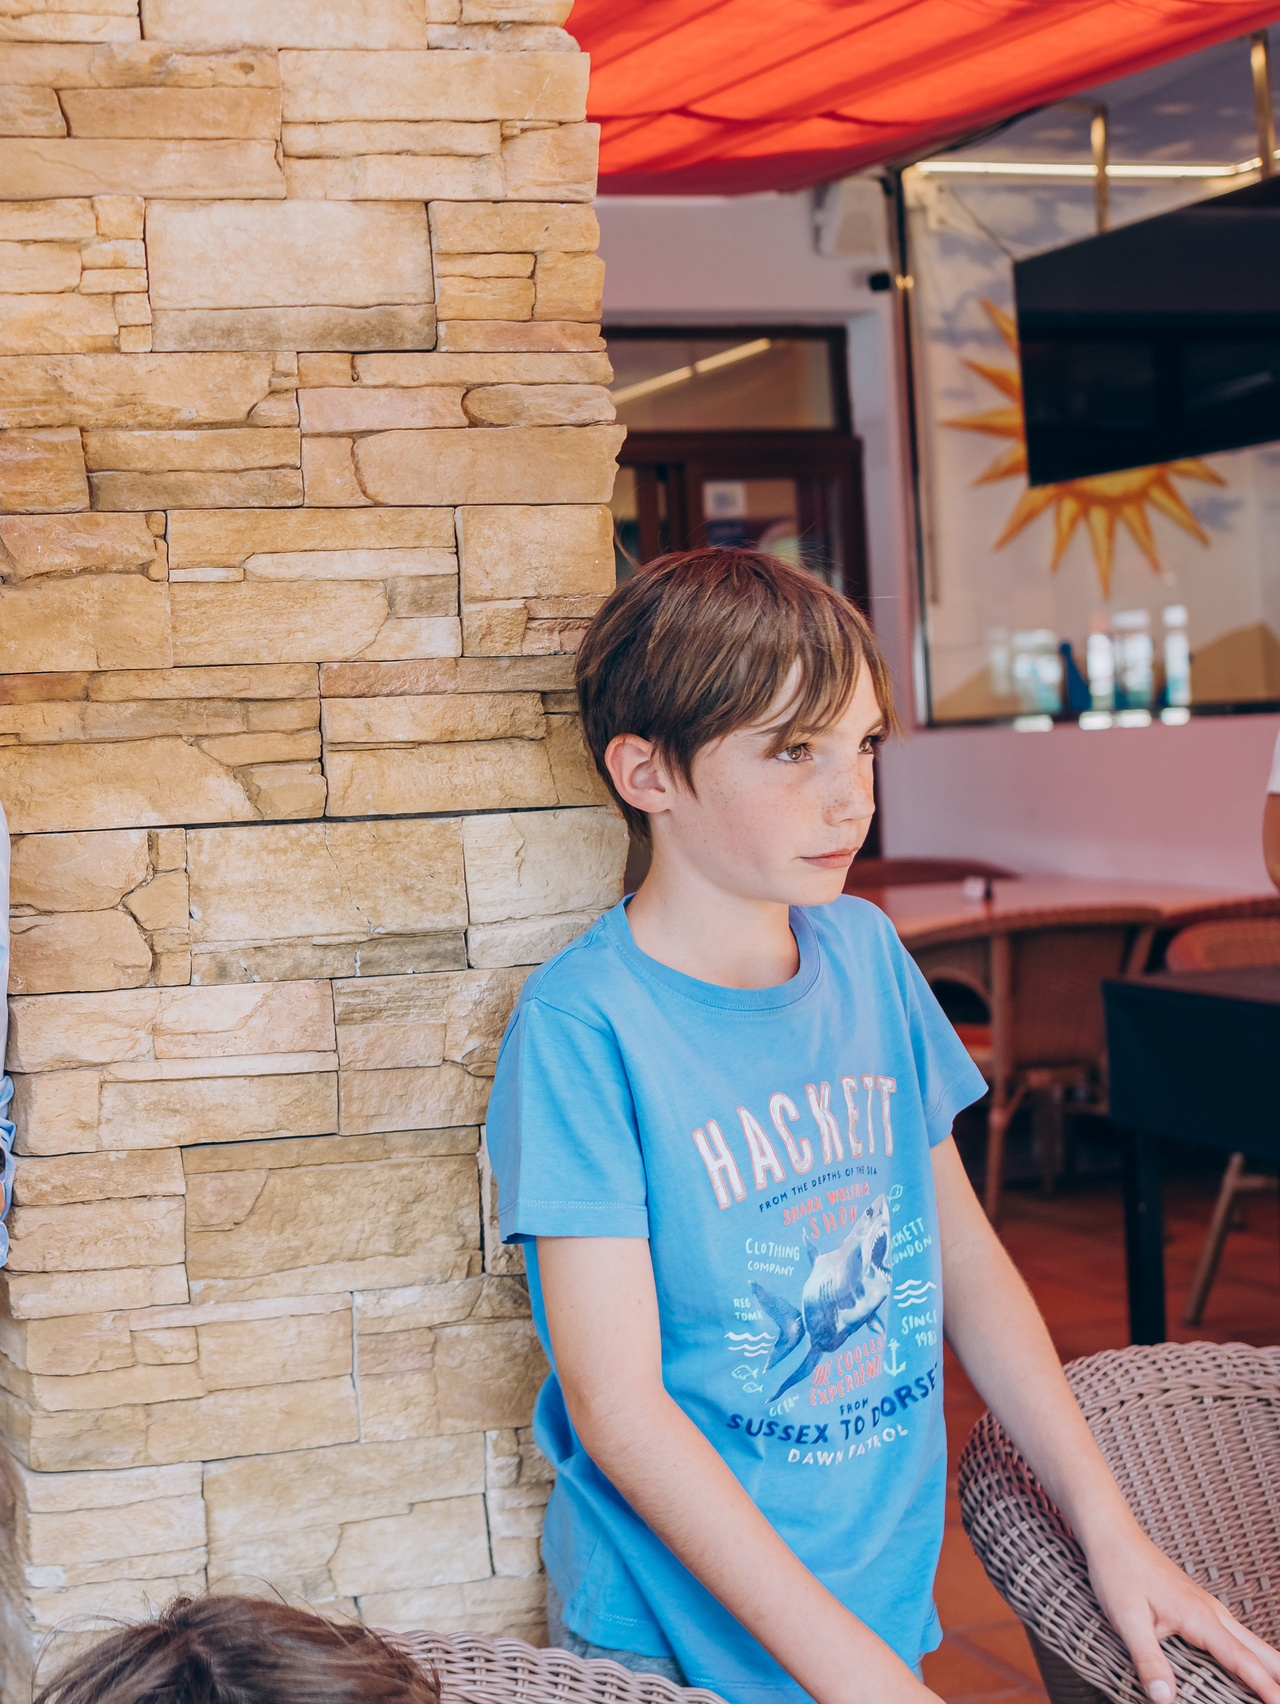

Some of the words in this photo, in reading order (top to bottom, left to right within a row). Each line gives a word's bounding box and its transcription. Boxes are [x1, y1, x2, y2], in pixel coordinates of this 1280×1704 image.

[691, 1074, 897, 1210] HACKETT
[759, 1192, 788, 1213] FROM
[791, 1182, 808, 1196] THE
[811, 1170, 842, 1188] DEPTHS
[845, 1167, 854, 1177] OF
[856, 1165, 865, 1175] THE
[866, 1165, 878, 1176] SEA
[783, 1196, 823, 1226] SHARK
[809, 1204, 858, 1239] SHOW
[745, 1237, 800, 1261] CLOTHING
[891, 1217, 925, 1249] CKETT
[891, 1235, 932, 1267] ONDON
[747, 1260, 795, 1277] COMPANY
[733, 1297, 751, 1309] REG
[812, 1360, 832, 1386] THE
[836, 1335, 887, 1376] COOLES
[810, 1354, 883, 1406] EXPERIENC
[726, 1413, 829, 1445] SUSSEX
[840, 1415, 866, 1440] TO
[872, 1360, 938, 1428] DORSE
[839, 1396, 869, 1416] FROM
[787, 1448, 844, 1466] DAWN
[848, 1423, 909, 1460] PATROL
